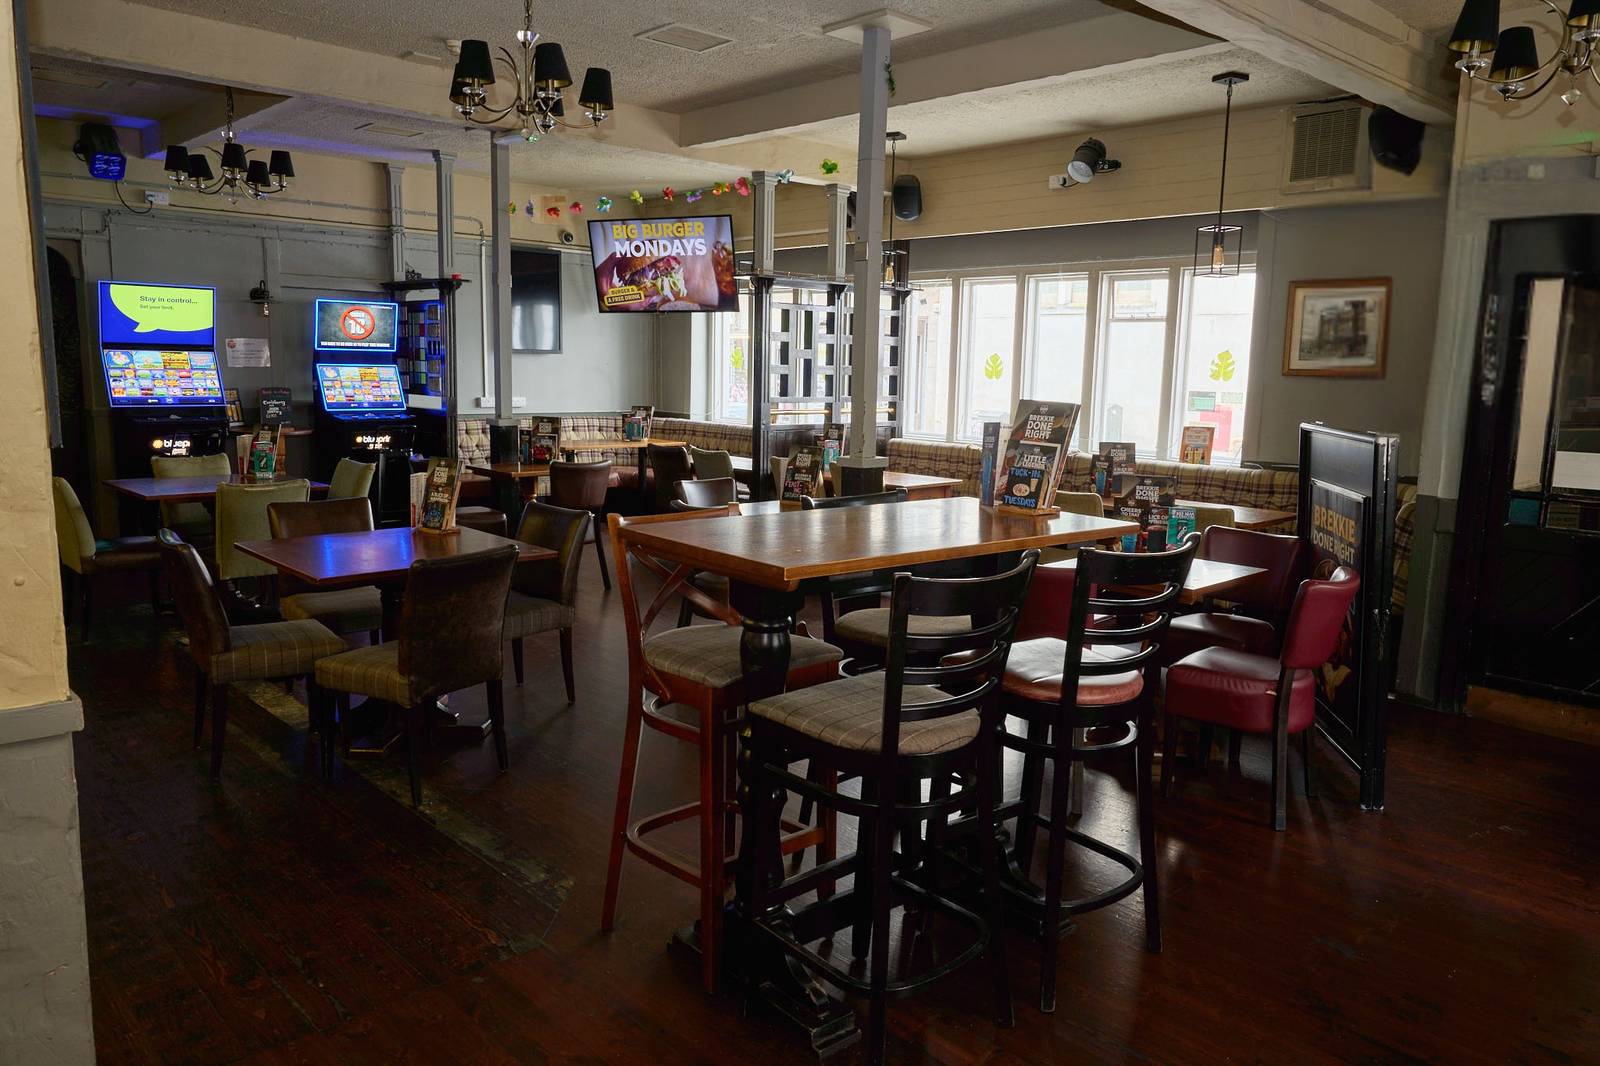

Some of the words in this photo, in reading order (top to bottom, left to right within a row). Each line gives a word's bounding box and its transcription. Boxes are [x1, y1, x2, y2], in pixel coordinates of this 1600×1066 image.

[612, 224, 638, 239] BIG
[641, 221, 705, 239] BURGER
[614, 238, 707, 258] MONDAYS
[139, 295, 156, 303] Stay
[1029, 414, 1055, 422] BREKKIE
[1027, 421, 1054, 431] DONE
[1025, 430, 1052, 439] RIGHT
[1023, 454, 1047, 463] LITTLE
[1004, 495, 1037, 507] TUESDAYS
[1314, 504, 1356, 544] BREKKIE
[1313, 529, 1334, 552] DONE
[1334, 540, 1355, 565] RIGHT
